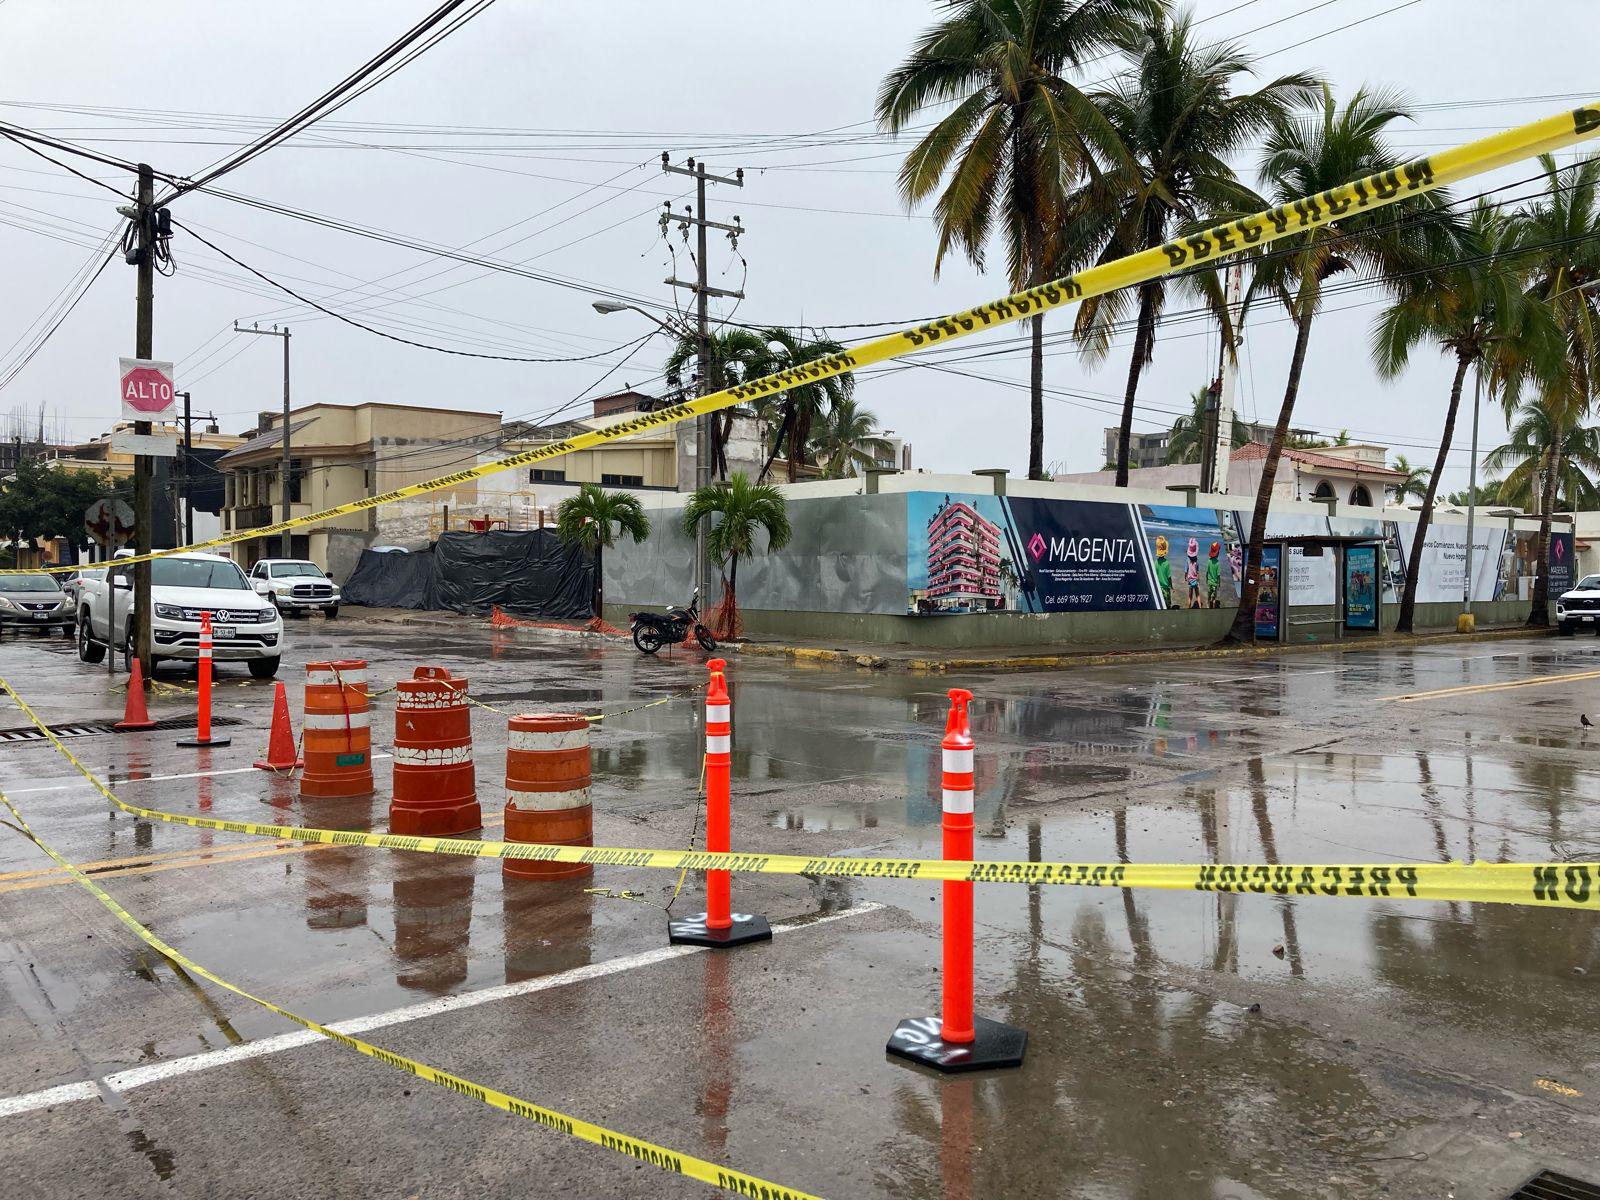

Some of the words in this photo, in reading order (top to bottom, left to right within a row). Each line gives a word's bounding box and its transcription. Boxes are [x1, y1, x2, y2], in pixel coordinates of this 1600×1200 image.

[126, 381, 170, 400] ALTO
[1049, 537, 1135, 563] MAGENTA
[1444, 552, 1455, 560] Nuevo
[1456, 553, 1467, 561] Hoga
[1551, 566, 1568, 574] MAGENTA
[1057, 595, 1068, 604] 669
[1069, 595, 1079, 603] 196
[1079, 594, 1092, 603] 1927
[1115, 594, 1126, 602] 669
[1127, 594, 1136, 602] 139
